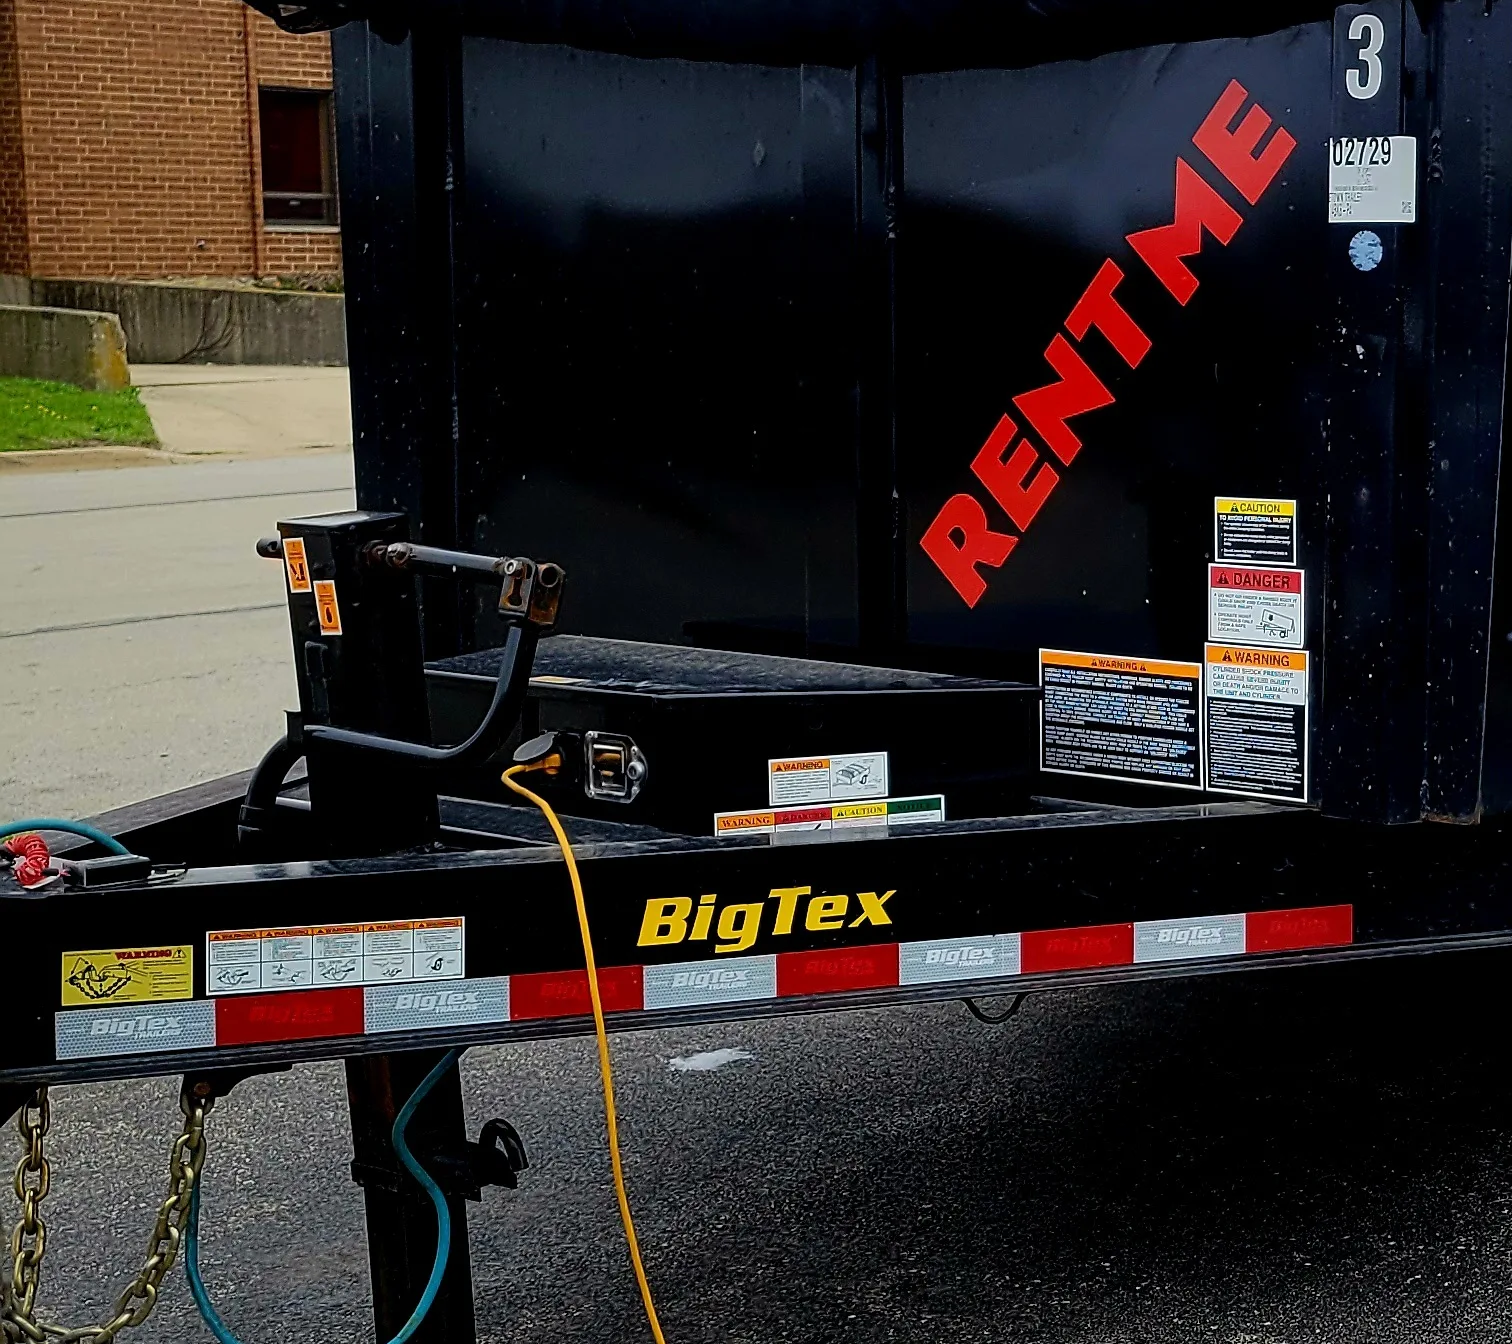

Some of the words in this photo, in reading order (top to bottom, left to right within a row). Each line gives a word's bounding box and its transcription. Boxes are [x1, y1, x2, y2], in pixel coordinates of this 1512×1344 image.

[1346, 14, 1384, 99] 3
[1332, 137, 1392, 167] 02729
[920, 257, 1152, 609] RENT
[1125, 78, 1297, 306] ME
[1240, 503, 1281, 513] CAUTION
[1233, 572, 1291, 589] DANGER
[1098, 660, 1138, 671] WARNING
[1234, 651, 1290, 667] WARNING
[783, 761, 823, 771] WARNING
[843, 806, 883, 817] CAUTION
[721, 816, 771, 828] WARNING
[637, 886, 897, 953] BigTex
[1157, 926, 1223, 944] BigTex
[114, 948, 172, 961] WARNING
[926, 946, 995, 965] BigTex
[669, 968, 750, 988] BigTex
[394, 989, 480, 1011] BigTex
[90, 1015, 183, 1037] BigTex
